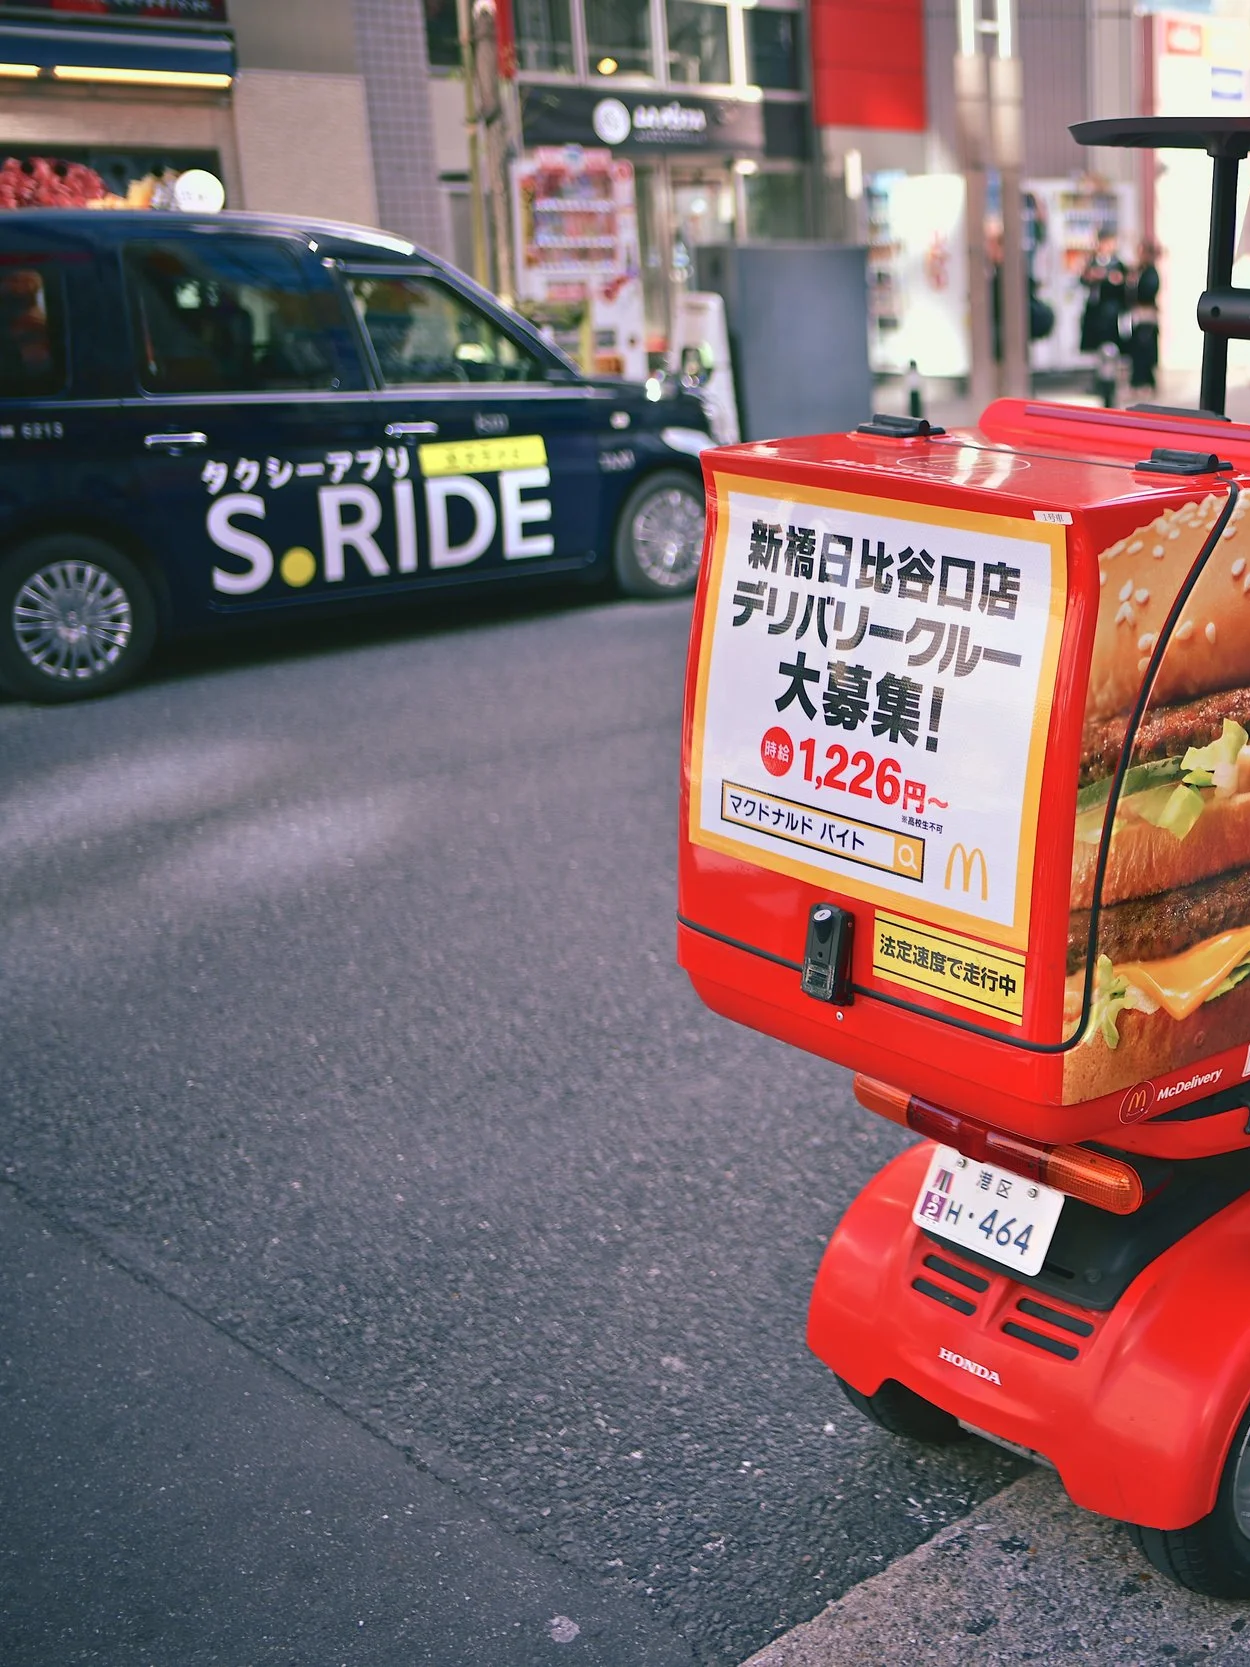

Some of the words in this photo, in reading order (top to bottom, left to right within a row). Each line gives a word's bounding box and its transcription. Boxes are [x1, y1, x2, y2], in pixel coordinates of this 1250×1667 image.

[202, 446, 410, 494] タクシーアプリ
[206, 466, 555, 595] S.RIDE
[748, 519, 1021, 621] 新橋日比谷口店
[732, 579, 1023, 678] デリバリークルー
[774, 651, 945, 752] 大募集!
[764, 740, 790, 763] 時給
[729, 793, 814, 836] マクドナルド
[820, 822, 865, 850] バイト
[879, 933, 1017, 998] 法定速度で走行中
[1157, 1068, 1223, 1102] McDelivery
[977, 1170, 1013, 1199] 港区
[938, 1347, 1002, 1386] HONDA
